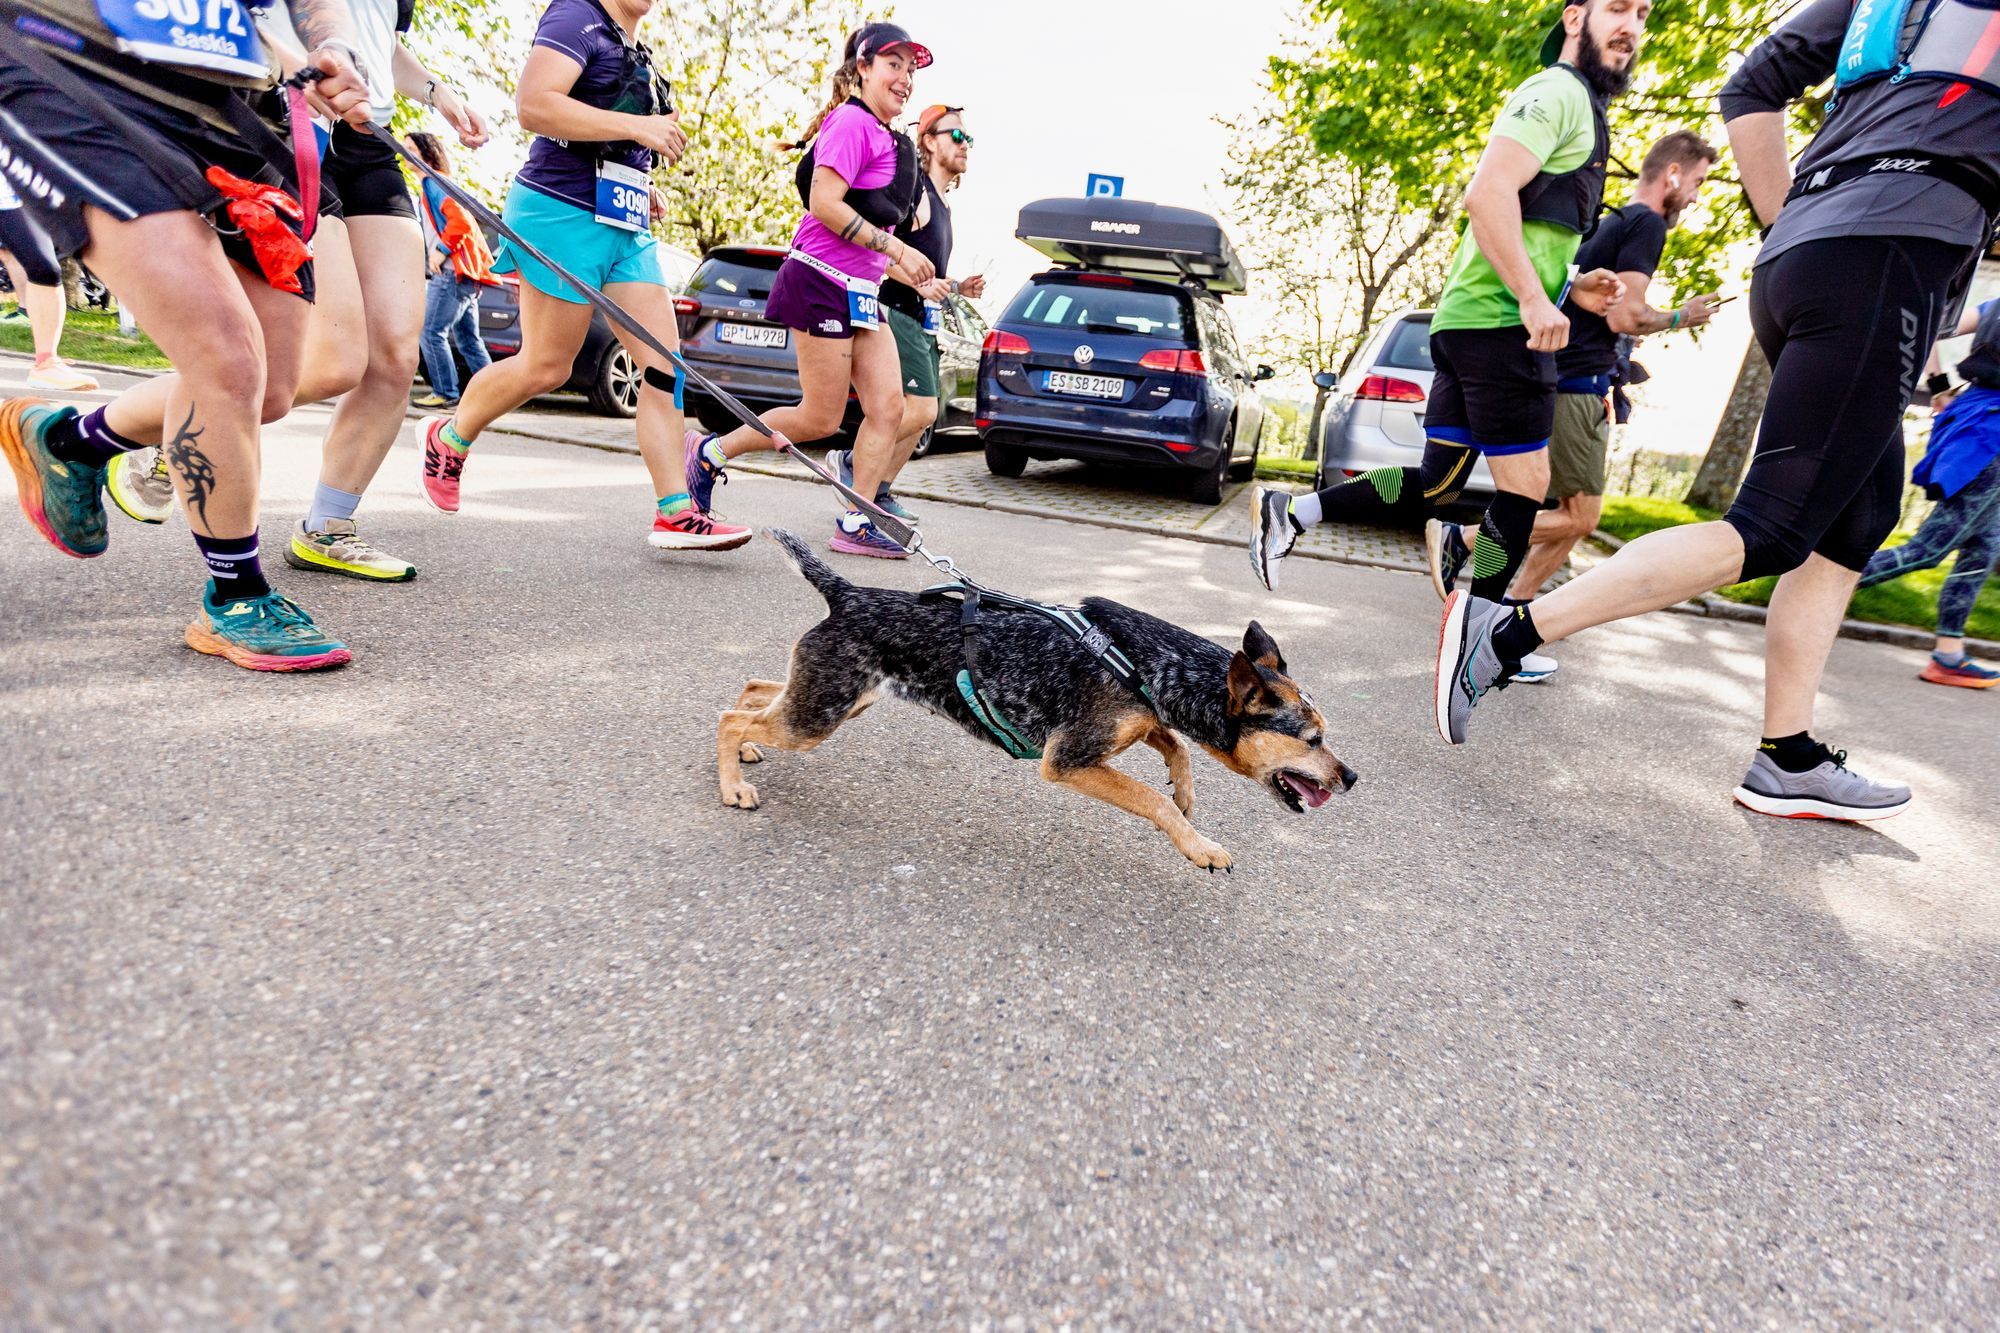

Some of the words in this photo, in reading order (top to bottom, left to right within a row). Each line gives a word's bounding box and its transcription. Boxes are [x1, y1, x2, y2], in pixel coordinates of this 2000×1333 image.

[168, 25, 239, 57] Saskia
[1093, 177, 1116, 199] P
[612, 185, 648, 217] 3090
[723, 324, 738, 338] GP
[745, 328, 760, 341] LW
[763, 329, 784, 344] 978
[1051, 373, 1067, 388] ES
[1074, 376, 1090, 390] SB
[1092, 378, 1122, 394] 2109
